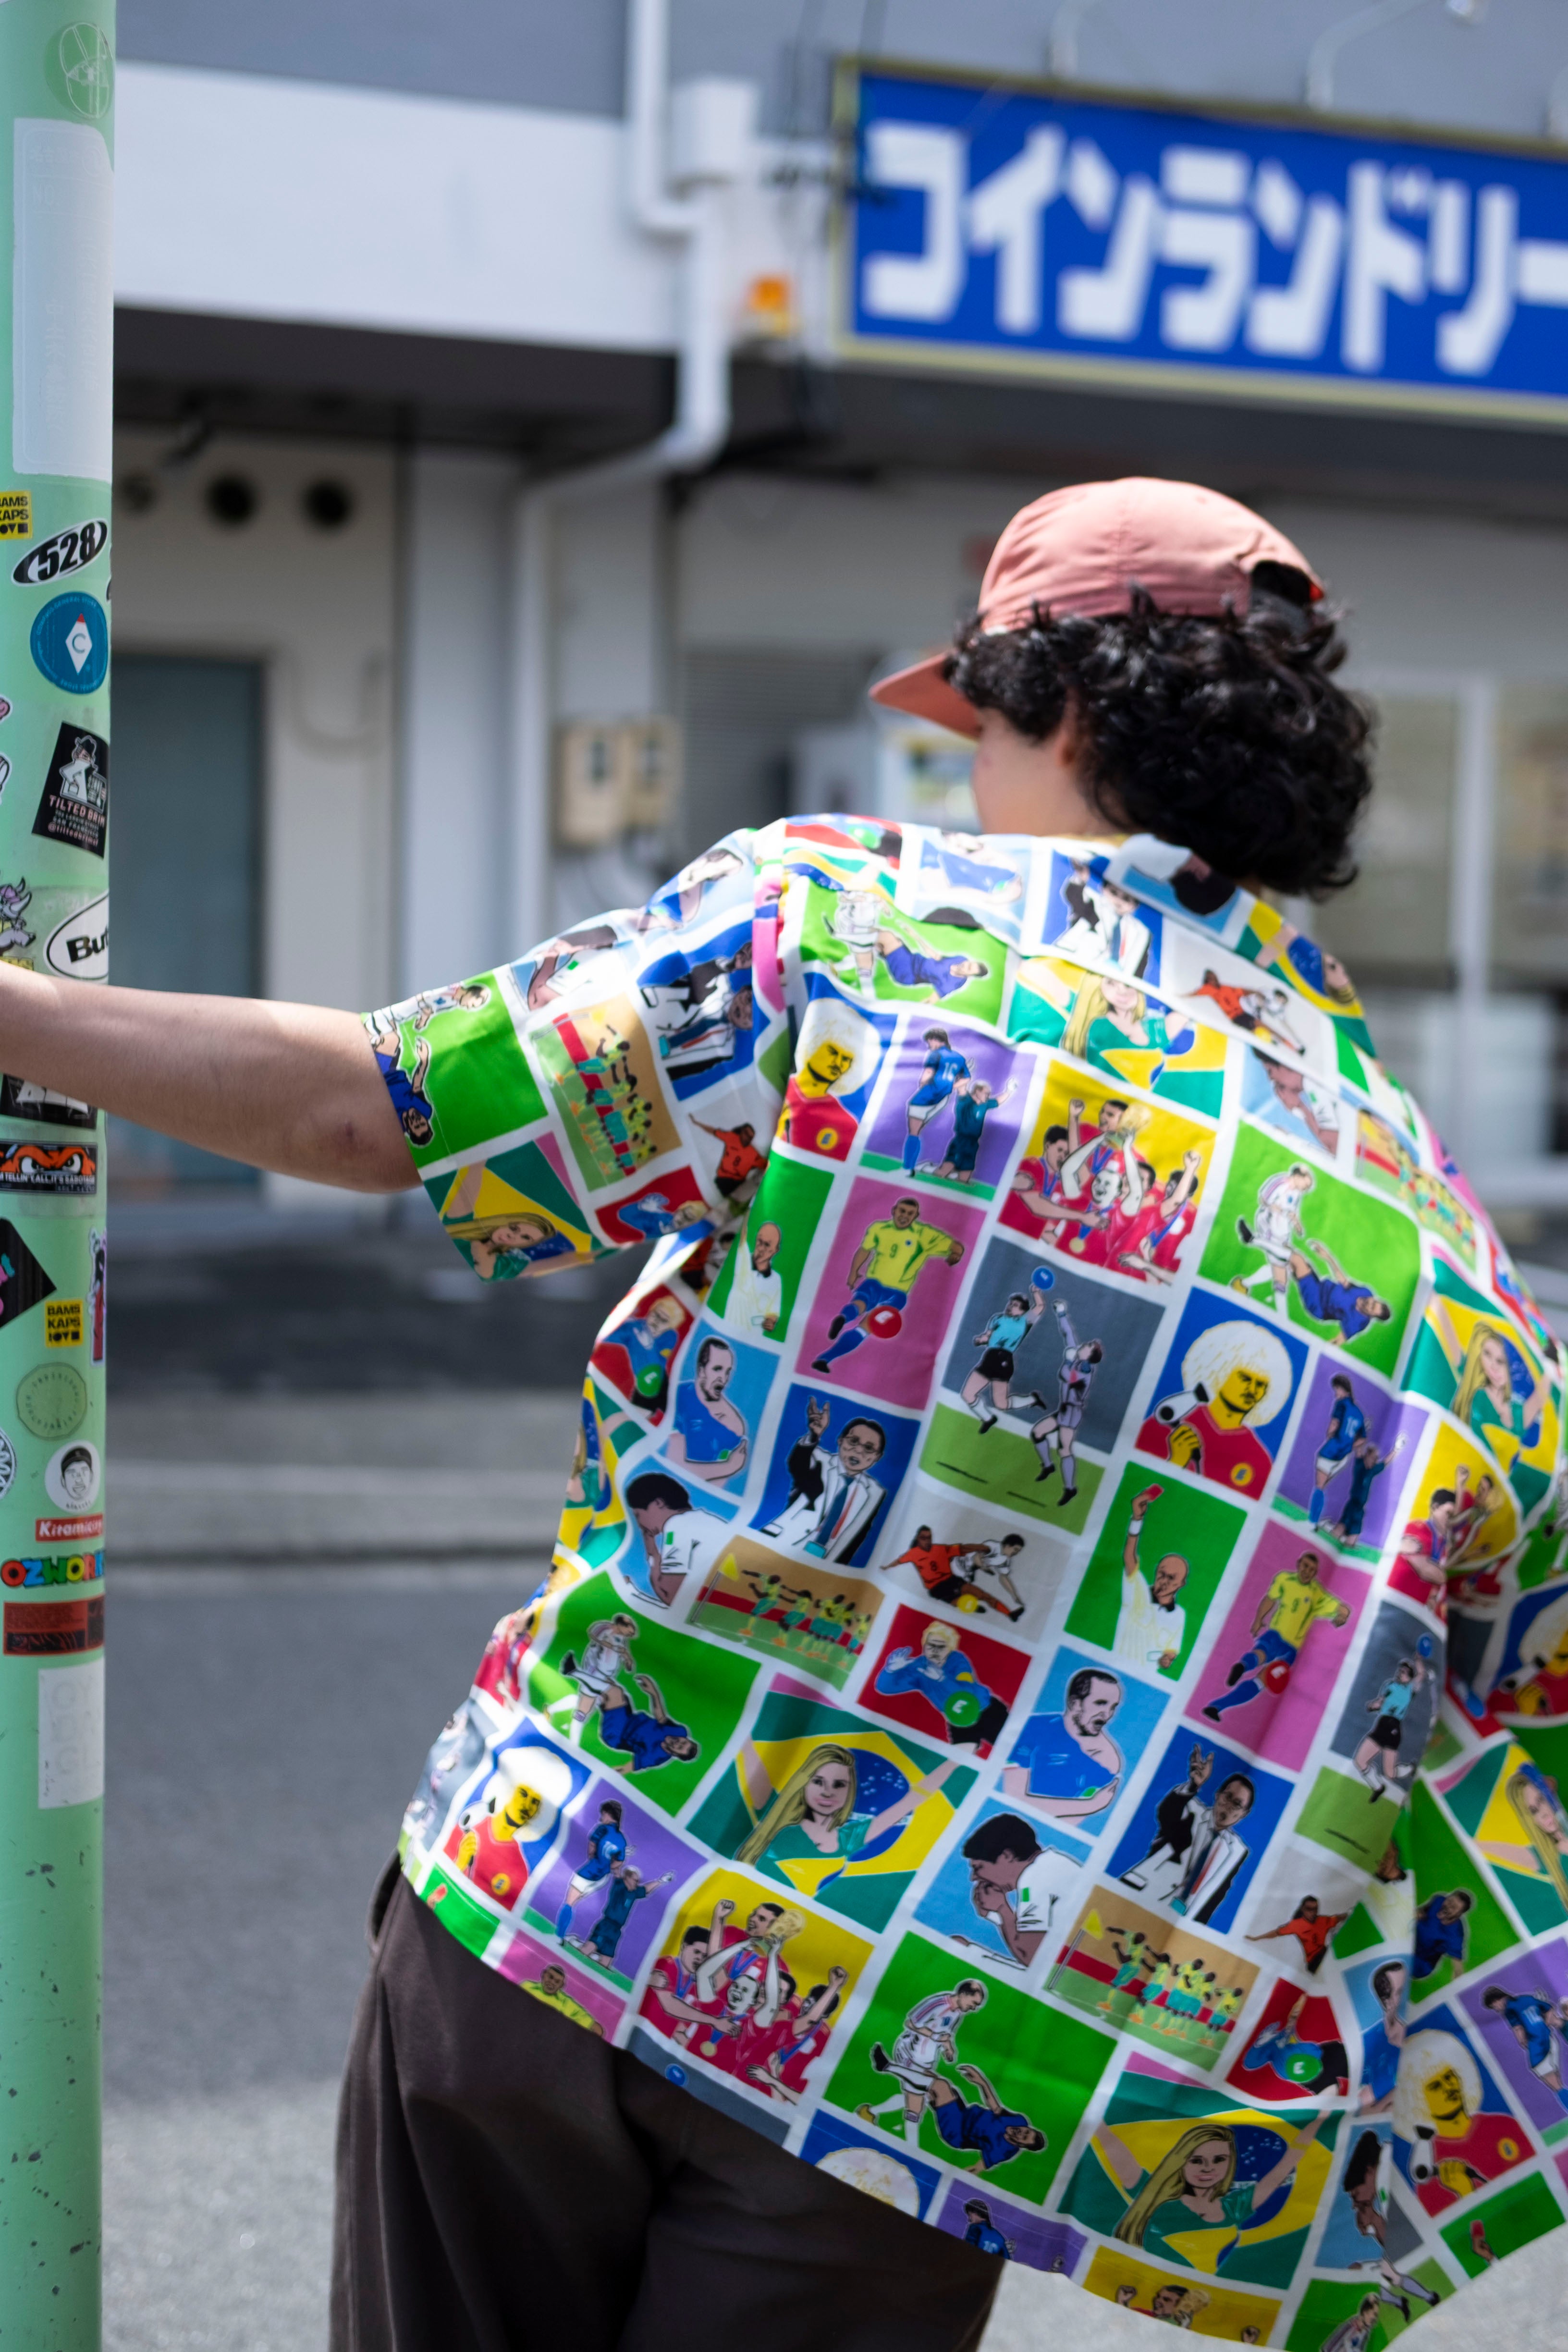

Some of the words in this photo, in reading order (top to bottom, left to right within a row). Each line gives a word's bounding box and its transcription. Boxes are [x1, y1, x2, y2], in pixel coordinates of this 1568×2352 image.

[863, 120, 1568, 375] コインランドリー
[0, 496, 28, 507] AMS
[38, 521, 96, 582] 528
[72, 632, 86, 654] C
[49, 795, 86, 818] TILTED
[87, 808, 106, 828] BRIM
[889, 1243, 898, 1259] 9
[1293, 2061, 1305, 2075] E
